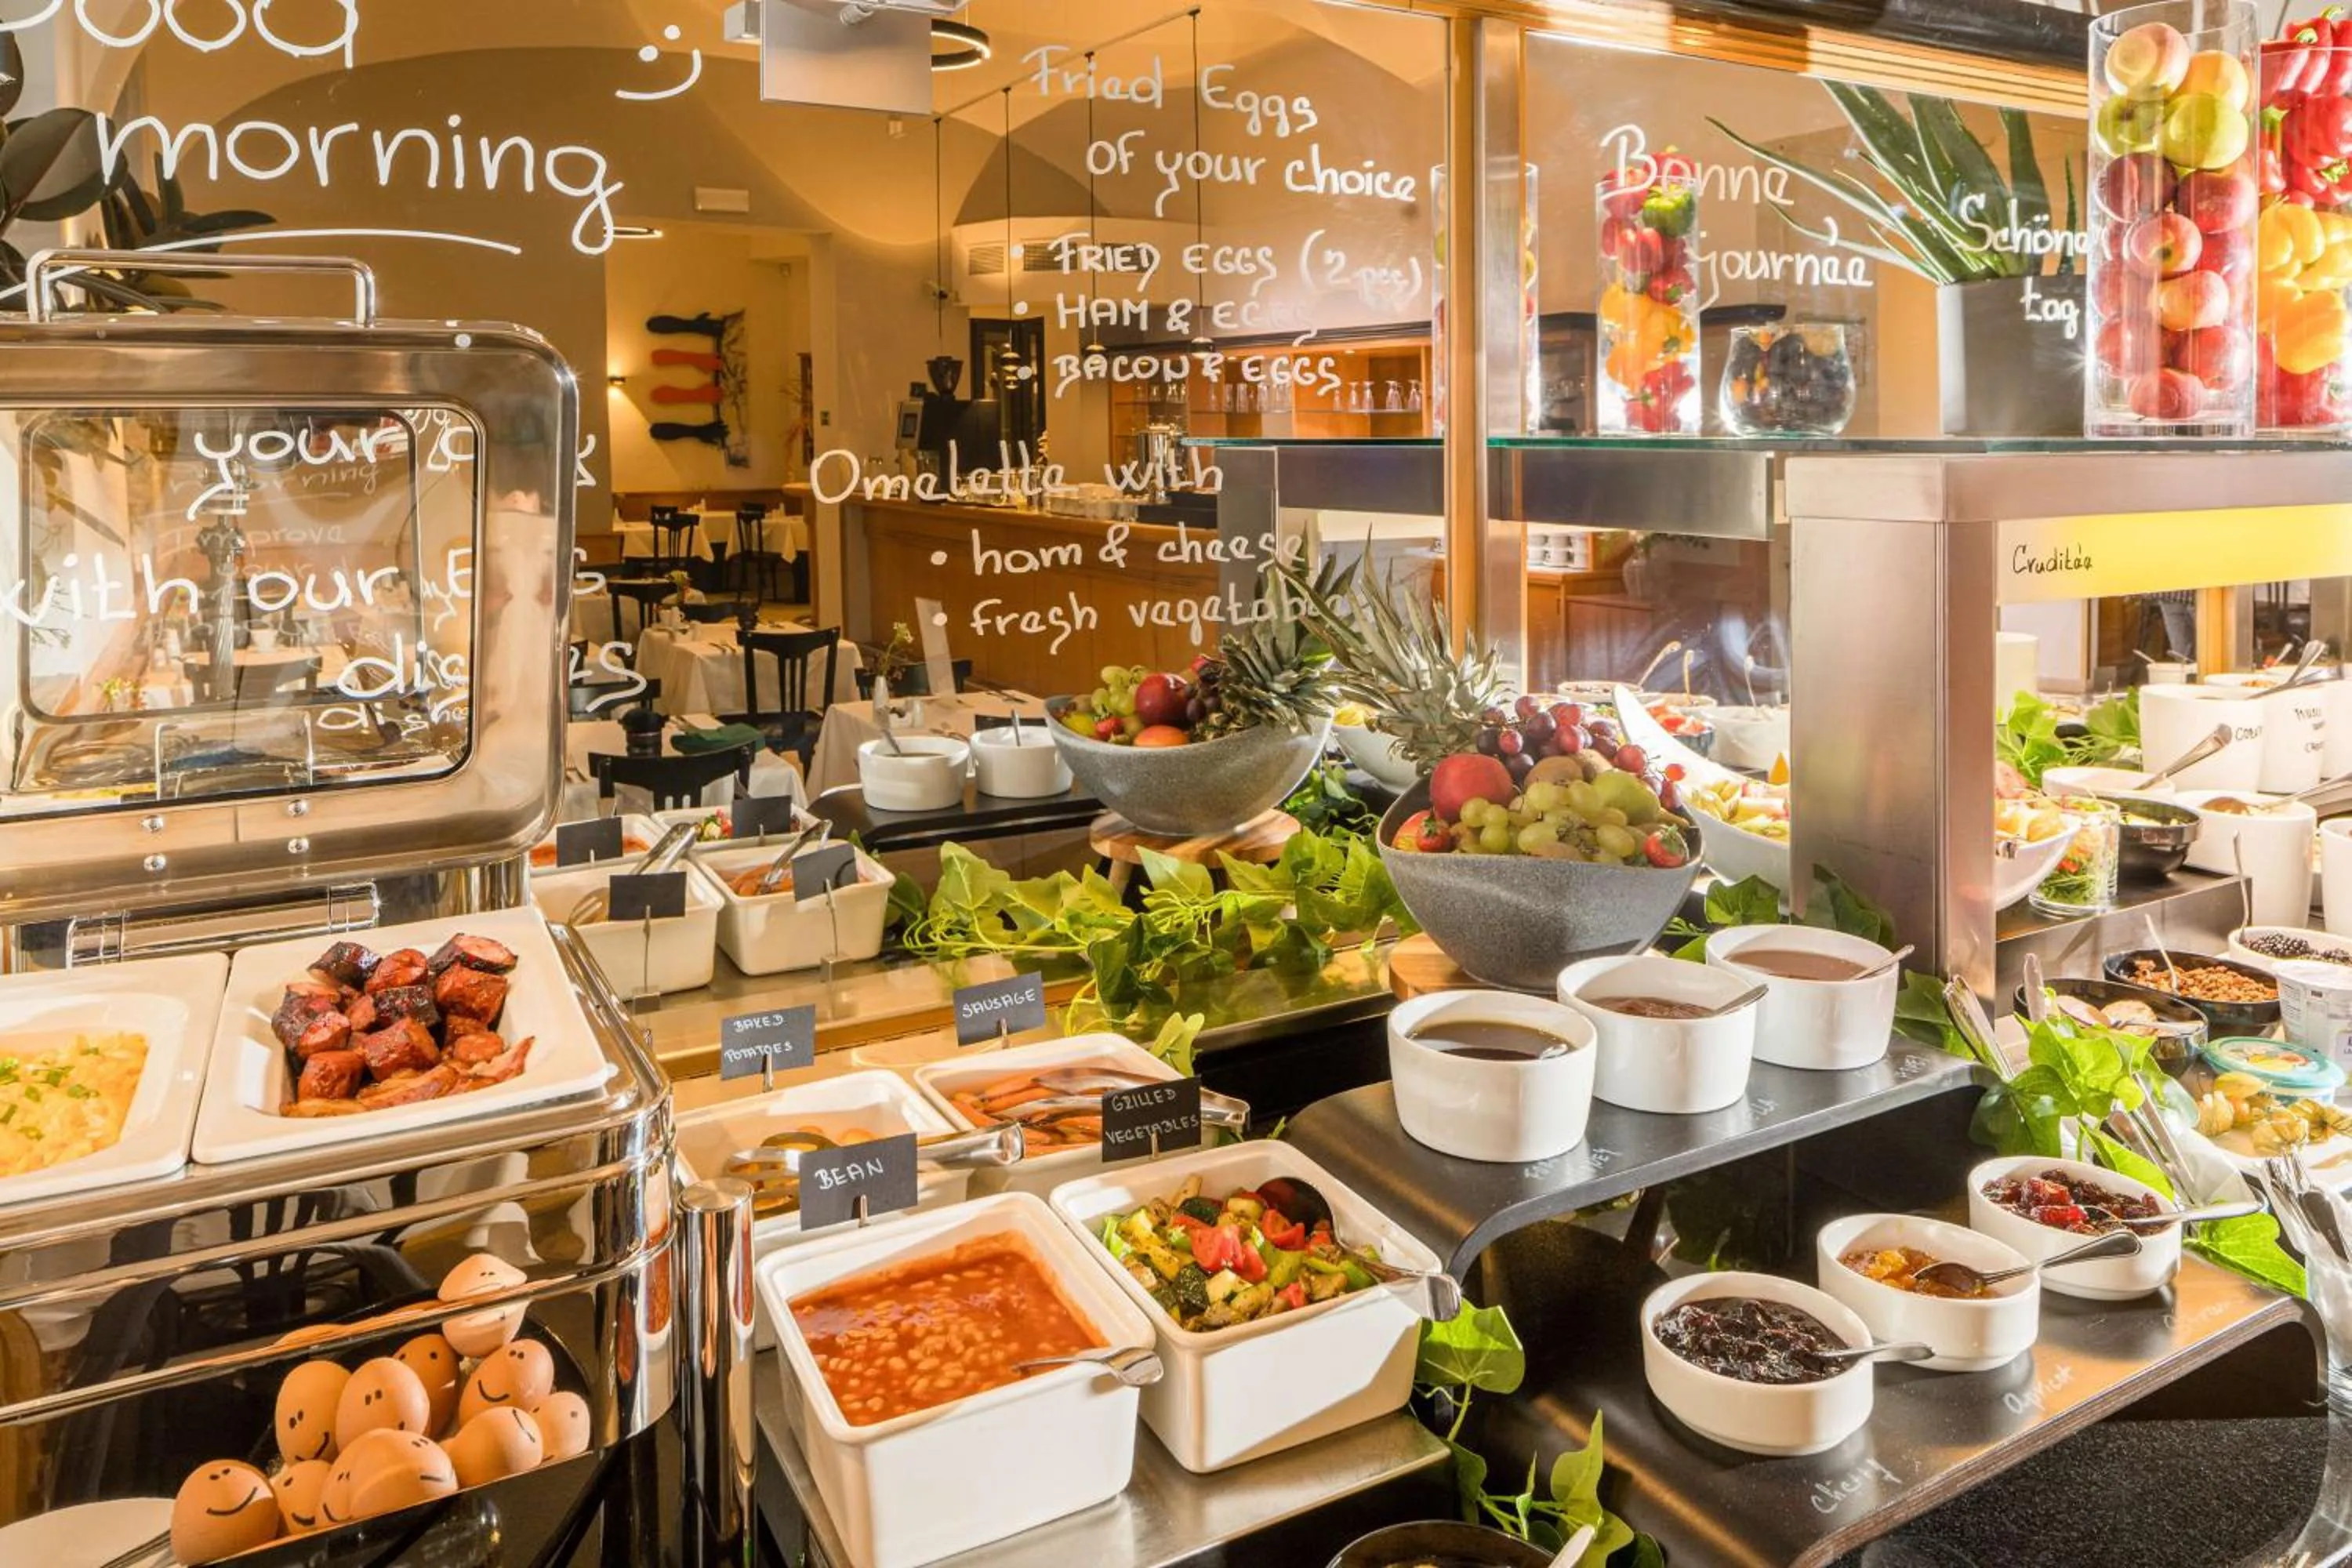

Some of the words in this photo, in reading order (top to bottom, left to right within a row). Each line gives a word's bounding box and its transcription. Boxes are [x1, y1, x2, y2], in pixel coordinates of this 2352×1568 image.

[1022, 45, 1163, 108] Fried
[1201, 64, 1318, 136] Eggs
[97, 112, 623, 255] morning
[1155, 149, 1266, 218] your
[1284, 144, 1417, 201] choice
[1599, 123, 1795, 206] Bonne
[1047, 232, 1160, 291] FRIED
[1182, 243, 1277, 296] EGGS
[1055, 293, 1149, 330] HAM
[1052, 355, 1189, 399] BACON
[1242, 355, 1341, 397] EGGS
[187, 426, 408, 521] your
[810, 440, 1080, 504] Omelette
[1103, 446, 1224, 495] with
[971, 529, 1082, 575] ham
[1098, 523, 1131, 569] &
[1156, 521, 1307, 572] cheese
[246, 566, 398, 612] our
[733, 1013, 784, 1033] BAKED
[961, 988, 1036, 1019] SAUSAGE
[724, 1041, 793, 1063] POTATOES
[1110, 1087, 1177, 1113] GRILLED
[1104, 1113, 1200, 1145] VEGETABLES
[814, 1156, 884, 1190] BEAN
